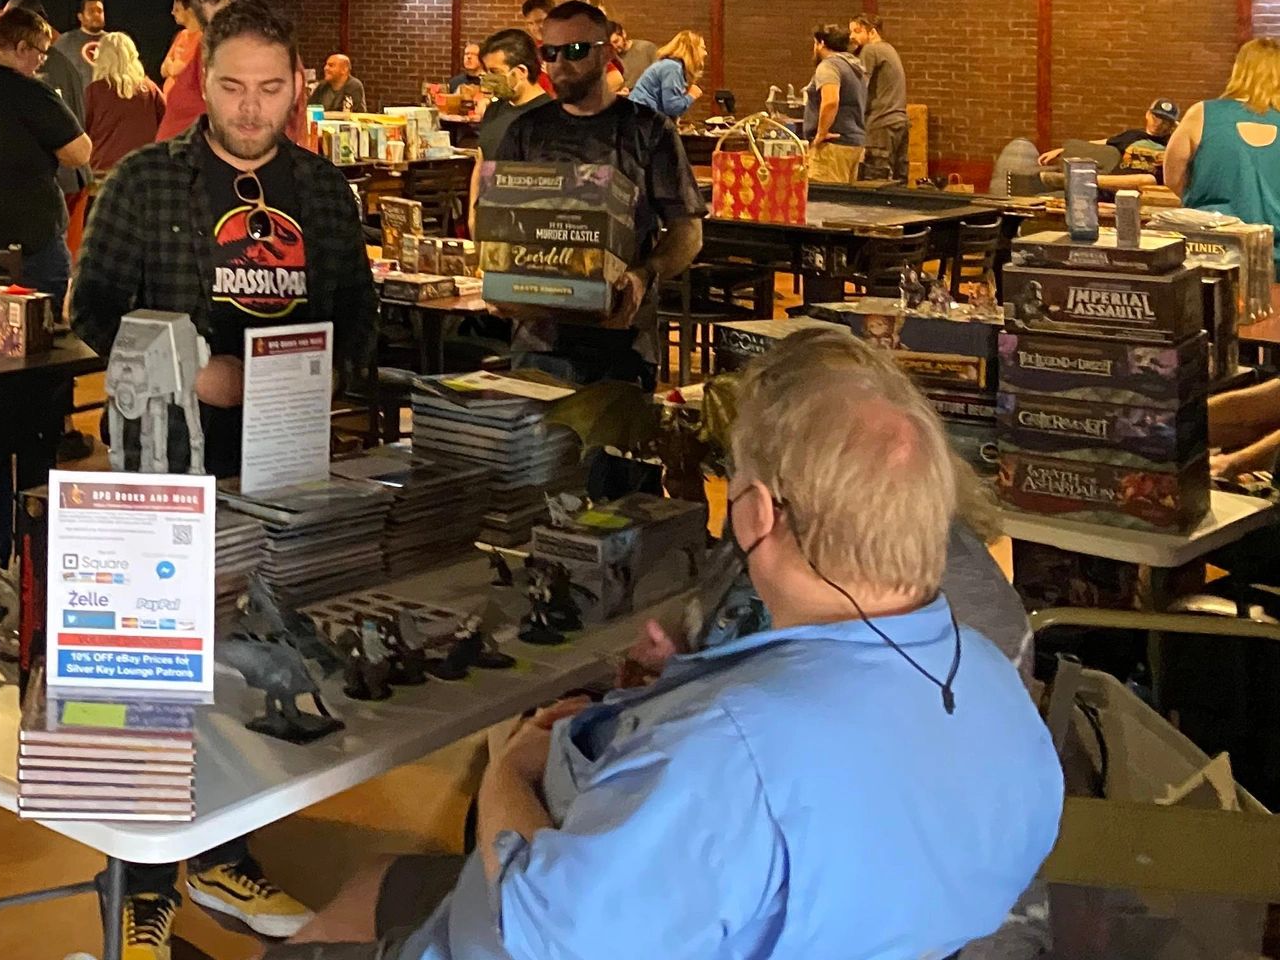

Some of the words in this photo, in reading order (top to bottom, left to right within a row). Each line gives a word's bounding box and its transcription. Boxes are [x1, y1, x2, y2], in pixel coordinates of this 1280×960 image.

[536, 228, 568, 241] MURDER
[570, 230, 600, 243] CASTLE
[512, 245, 574, 266] Everdell
[1066, 288, 1154, 316] IMPERIAL
[1072, 302, 1144, 320] ASSAULT
[81, 555, 130, 570] Square
[68, 590, 110, 607] Zelle
[136, 598, 182, 612] PayPal
[70, 653, 92, 662] 10%
[94, 653, 114, 663] OFF
[115, 655, 141, 666] eBay
[142, 655, 174, 665] Prices
[175, 656, 190, 666] for
[66, 664, 95, 674] Silver
[96, 665, 116, 676] Key
[117, 666, 154, 678] Lounge
[155, 668, 195, 678] Patrons
